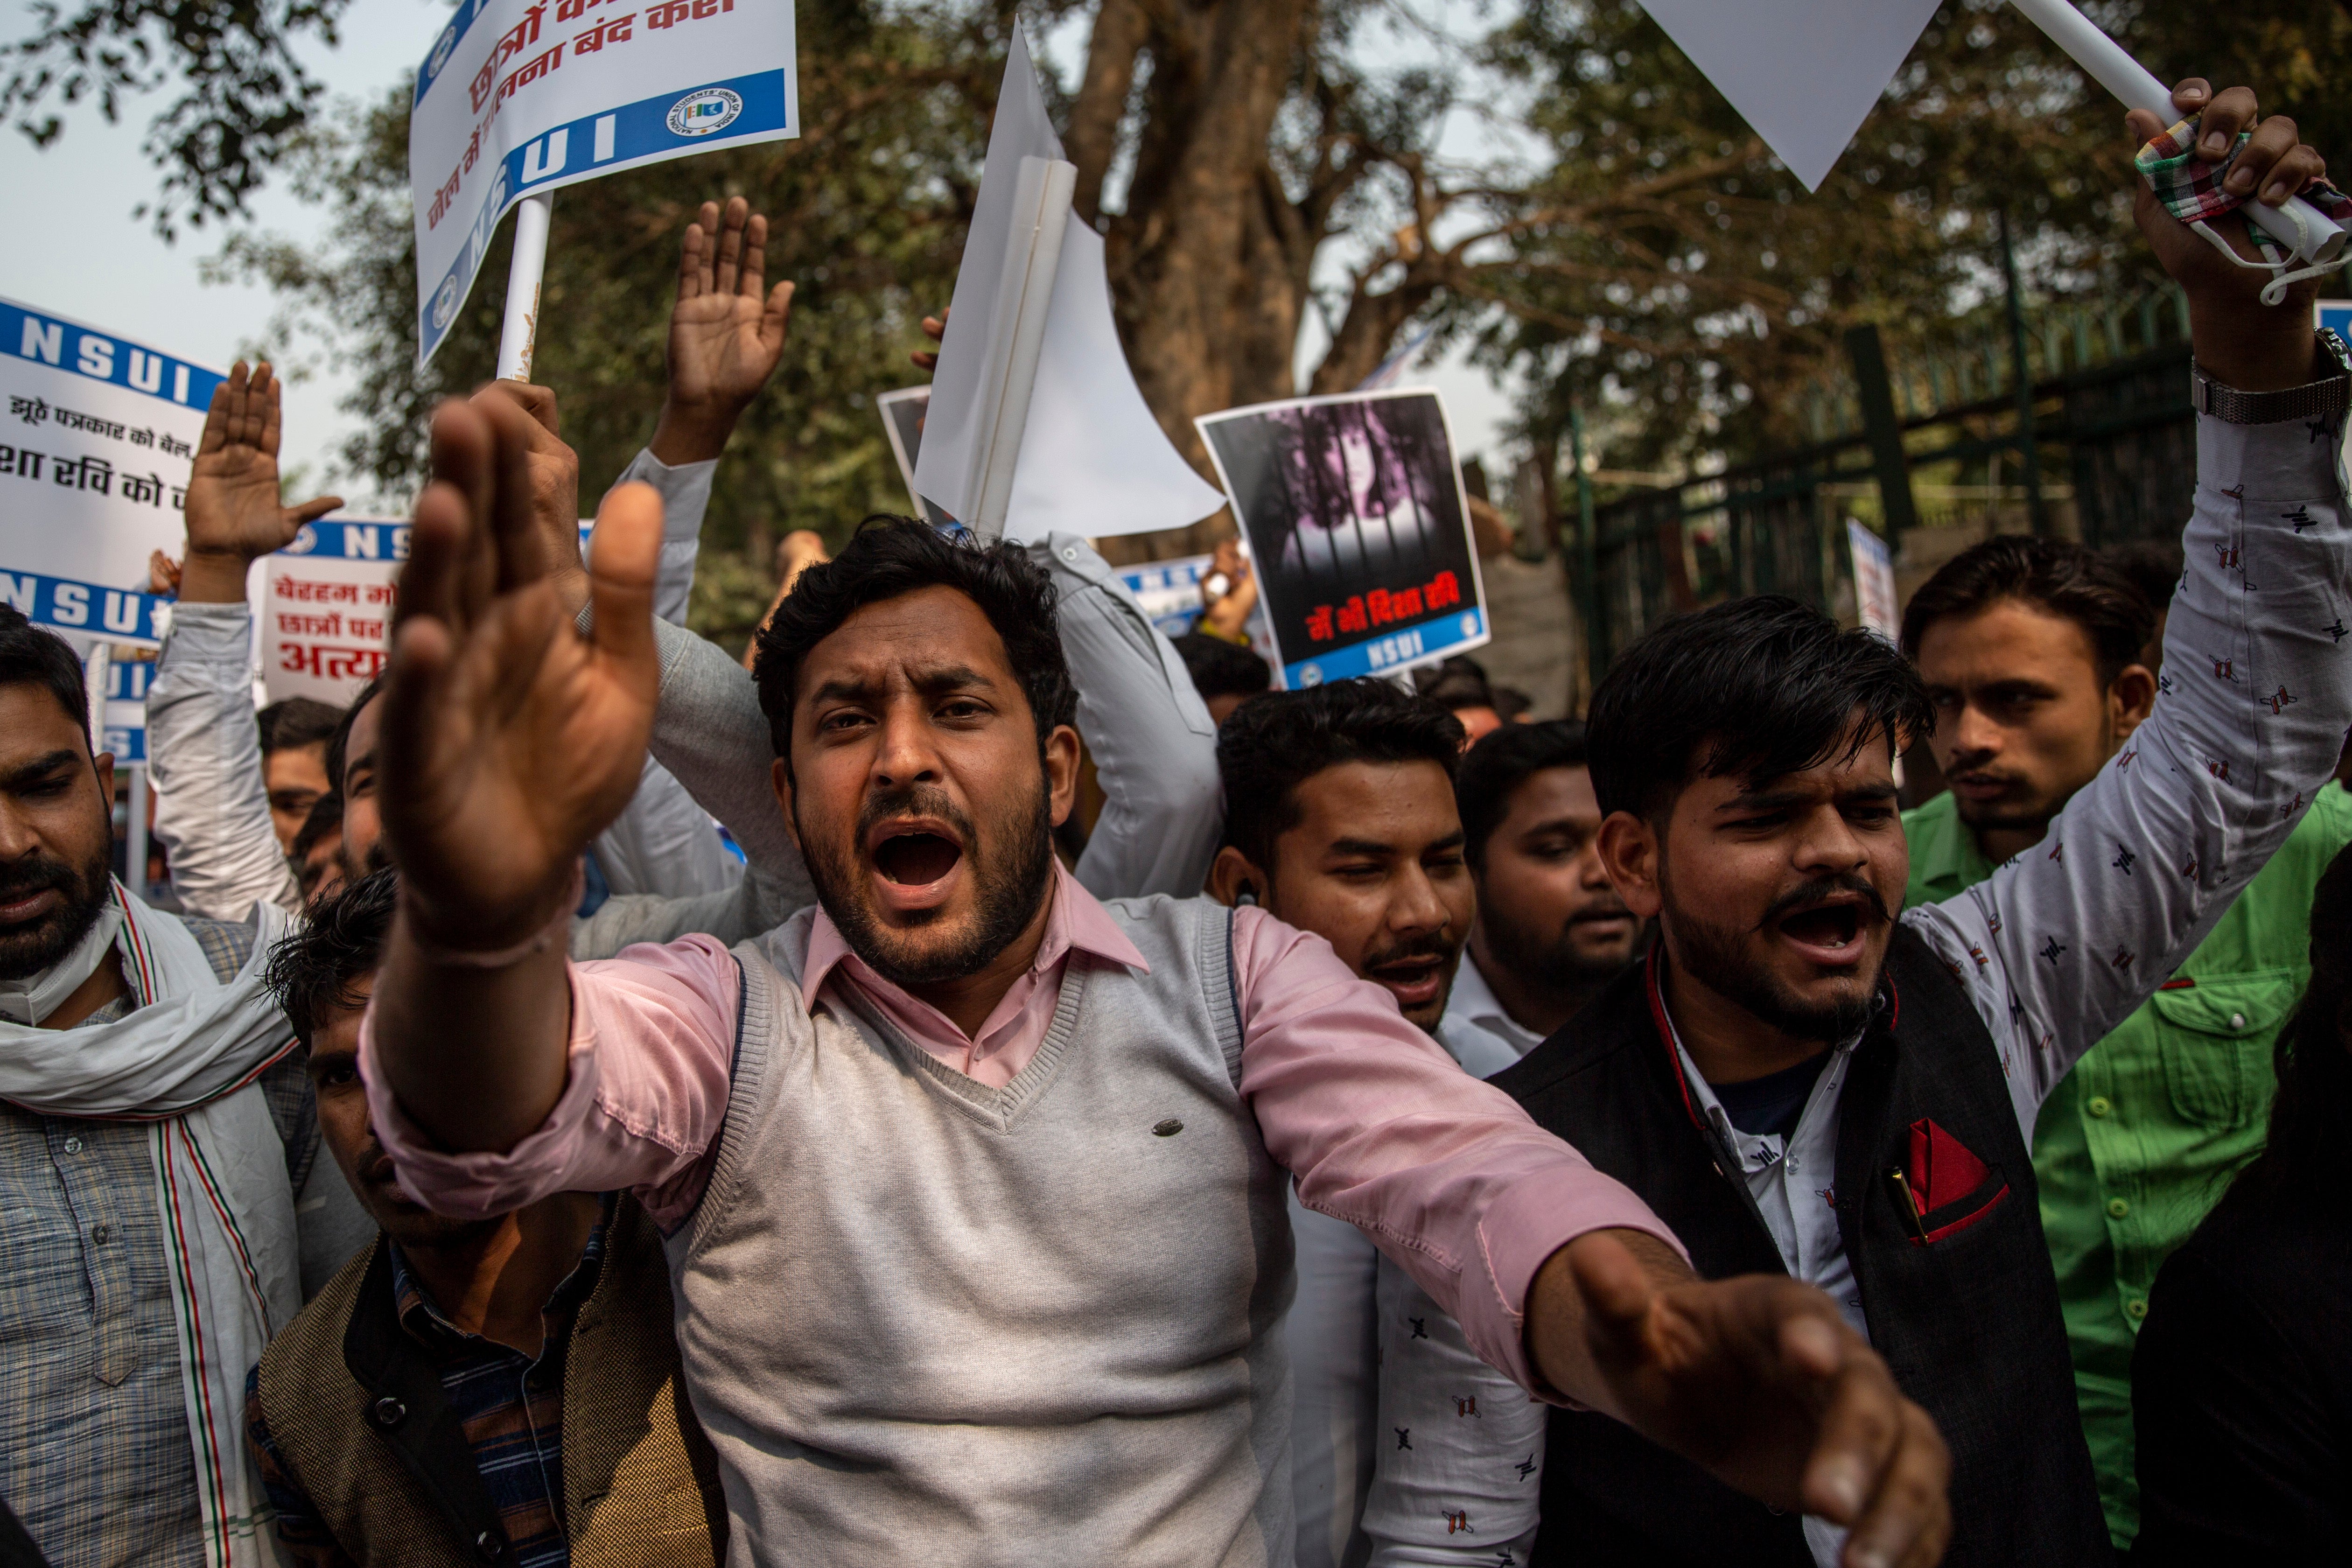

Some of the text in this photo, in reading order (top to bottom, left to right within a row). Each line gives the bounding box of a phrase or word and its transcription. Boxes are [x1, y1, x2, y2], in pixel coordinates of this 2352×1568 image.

[573, 16, 637, 56] बंद
[718, 90, 739, 104] UNION
[732, 104, 740, 112] OF
[669, 114, 693, 134] NATIONAL
[714, 113, 736, 128] INDIA
[469, 113, 616, 274] NSUI
[20, 315, 190, 405] NSUI
[9, 394, 49, 427] झूठे
[54, 406, 126, 441] पत्रकार
[130, 426, 155, 449] को
[52, 455, 113, 497] रवि
[121, 471, 164, 508] को
[274, 573, 358, 606] बेरहम
[278, 610, 341, 637] छात्रों
[1367, 629, 1424, 670] NSUI
